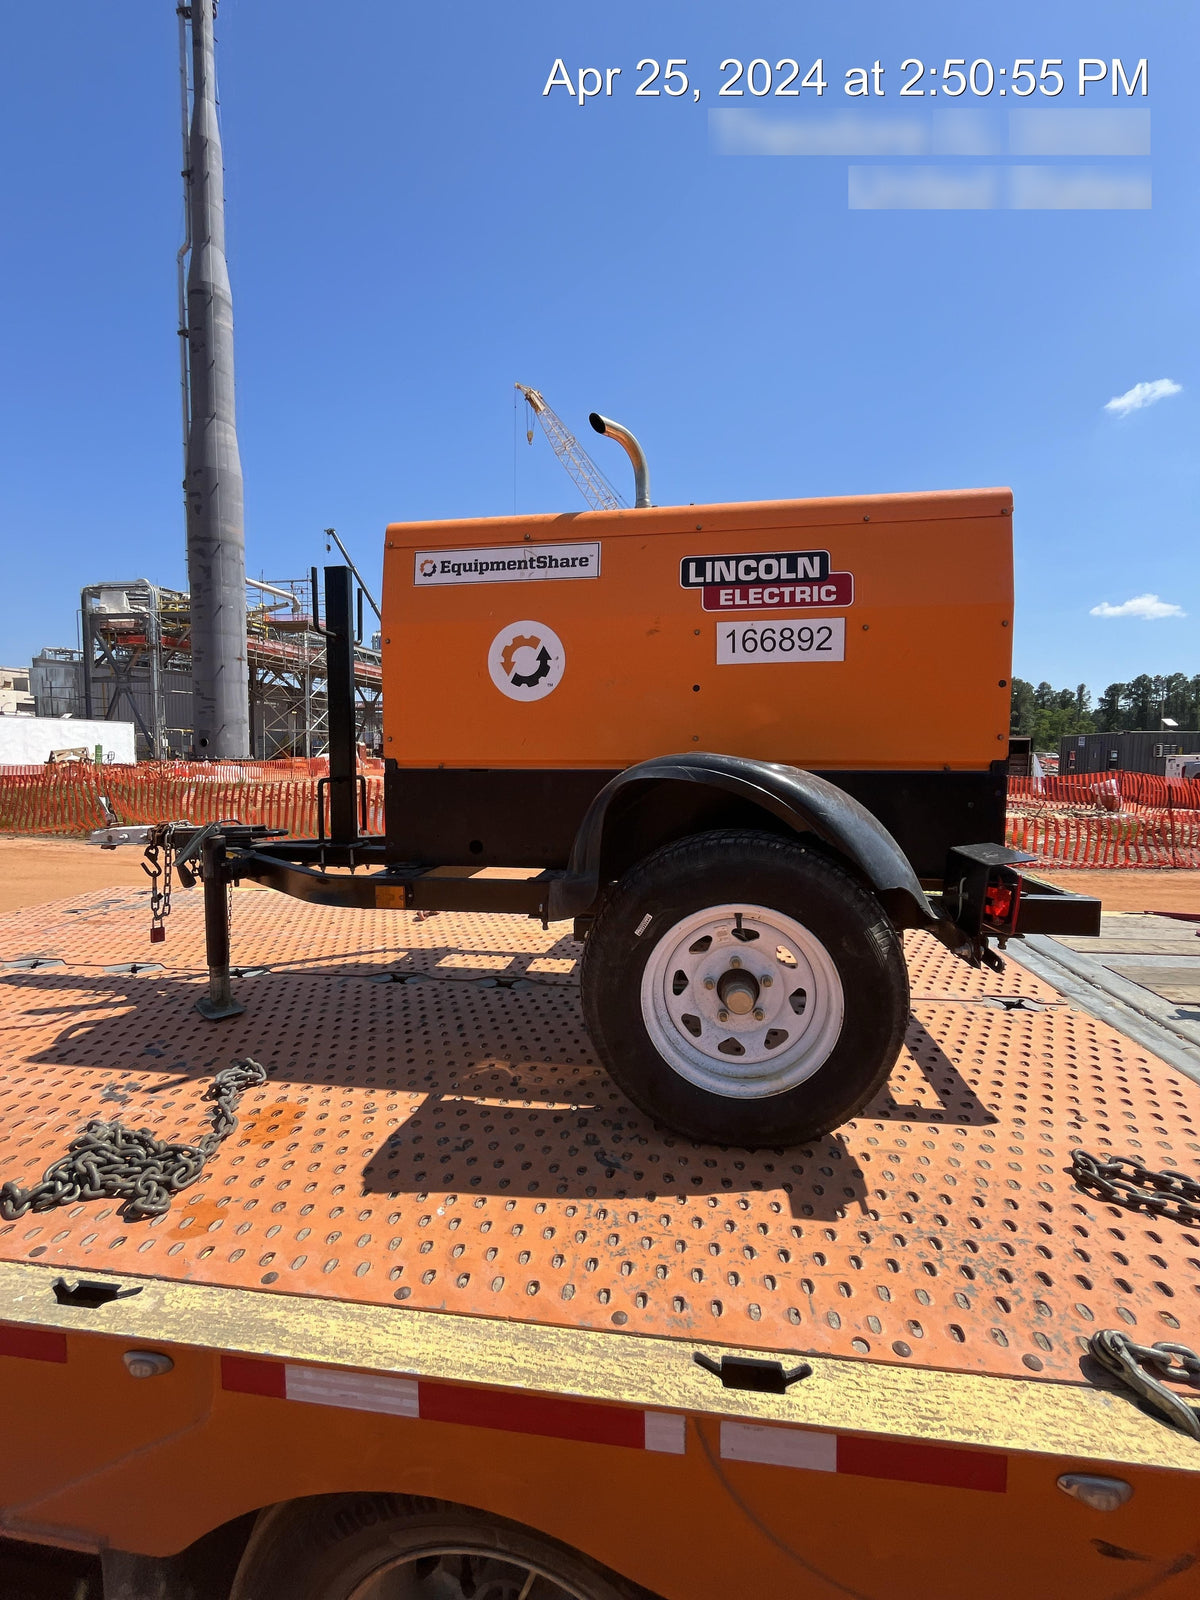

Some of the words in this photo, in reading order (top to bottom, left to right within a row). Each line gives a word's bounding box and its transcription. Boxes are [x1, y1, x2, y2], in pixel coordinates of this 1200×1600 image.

[440, 555, 590, 576] EquipmentShare
[688, 556, 821, 583] LINCOLN
[719, 585, 837, 606] ELECTRIC
[726, 626, 833, 654] 166892
